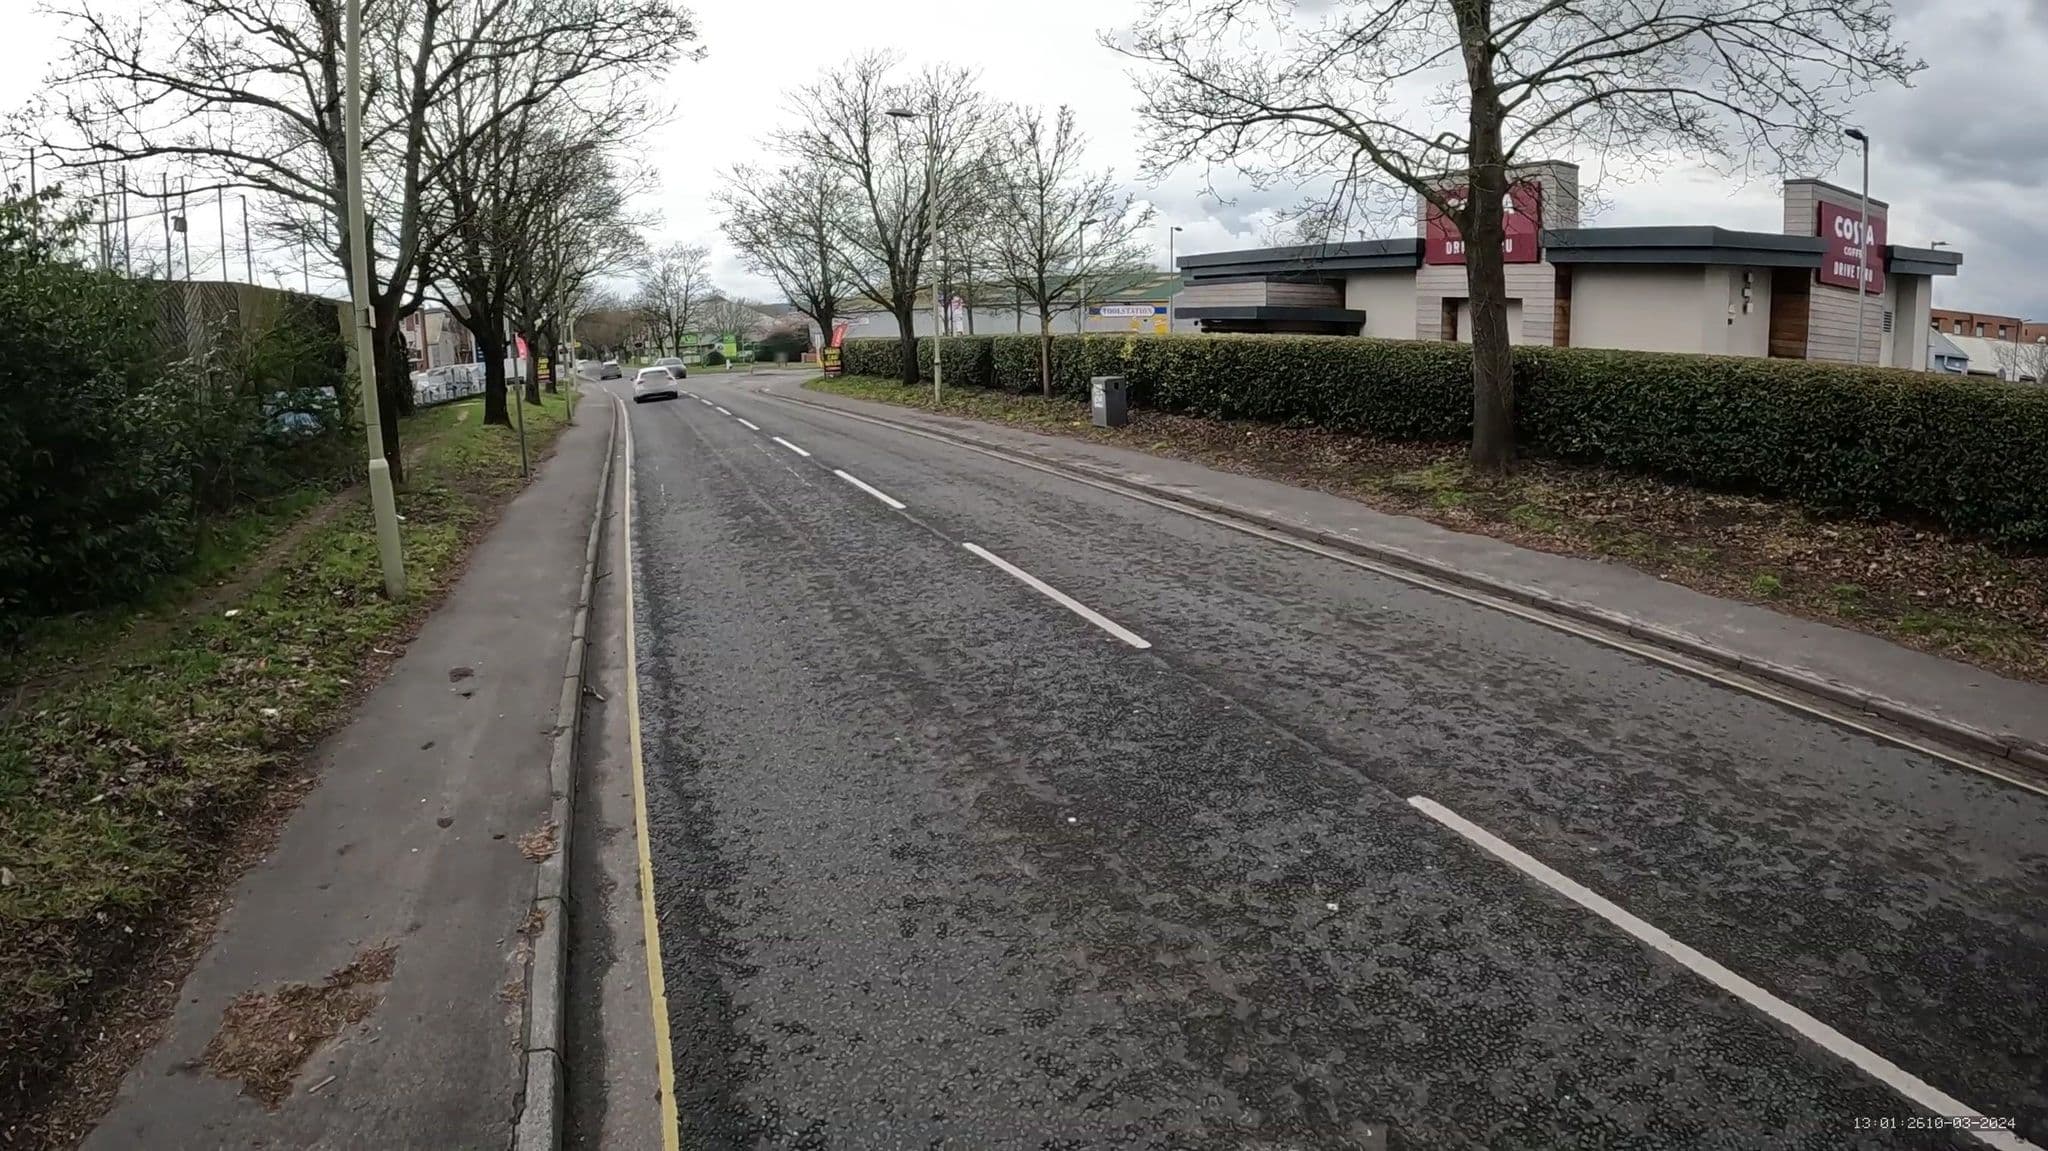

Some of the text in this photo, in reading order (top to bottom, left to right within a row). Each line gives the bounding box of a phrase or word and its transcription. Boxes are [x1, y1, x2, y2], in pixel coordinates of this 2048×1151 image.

[1835, 215, 1874, 246] COSA
[1844, 246, 1863, 258] COFFE
[1834, 261, 1855, 278] DRIVE
[1103, 306, 1152, 315] TOOLSTATION
